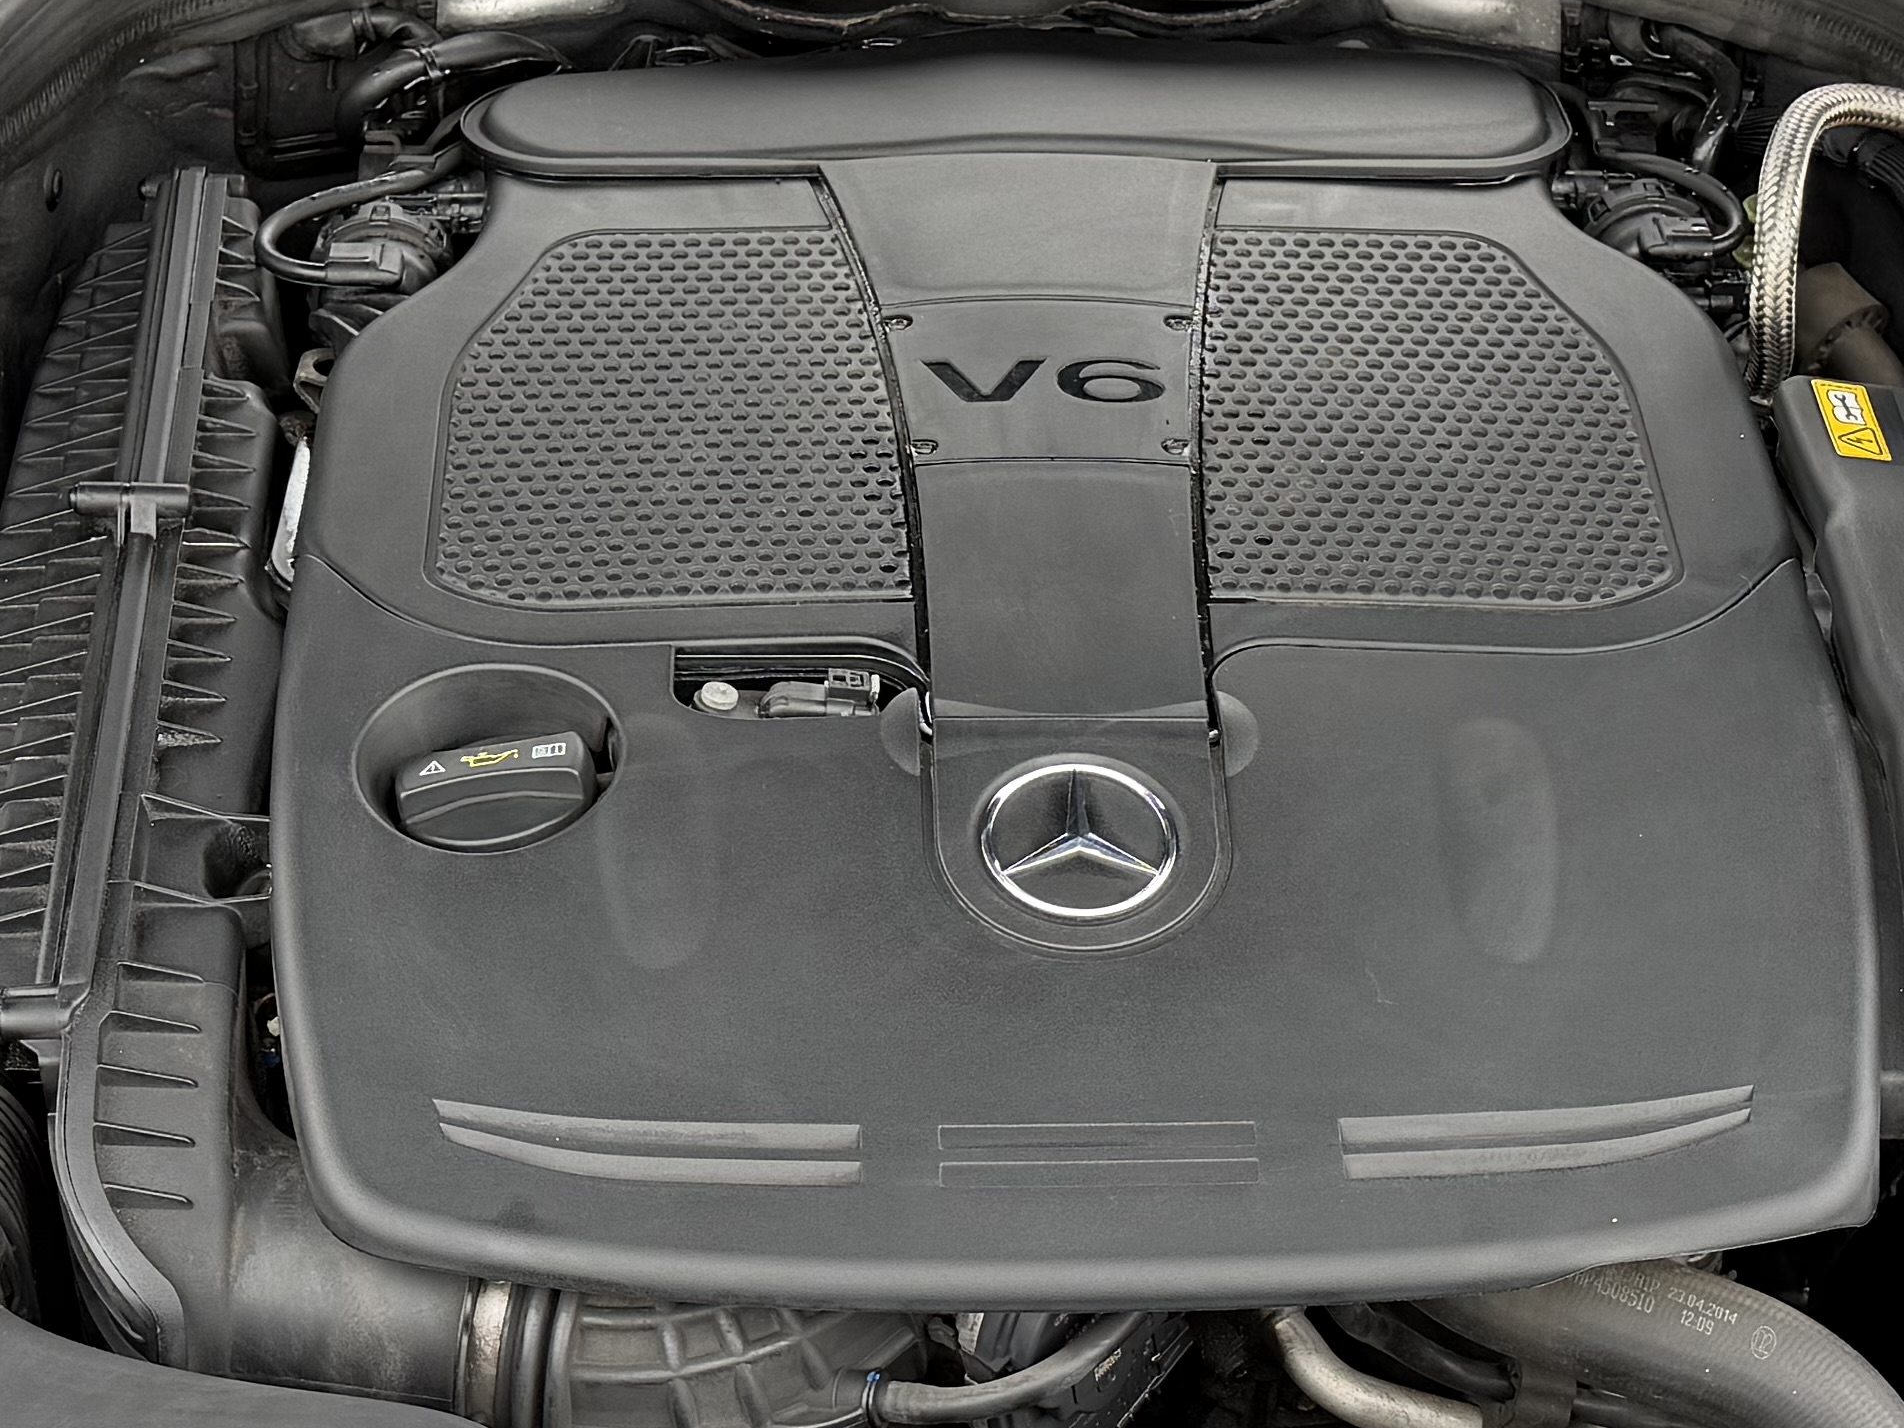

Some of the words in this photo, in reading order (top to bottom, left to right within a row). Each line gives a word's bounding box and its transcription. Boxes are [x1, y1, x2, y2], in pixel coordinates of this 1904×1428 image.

[919, 356, 1166, 404] V6
[1667, 1286, 1738, 1324] 23.04.2014
[1681, 1310, 1714, 1335] 12:09
